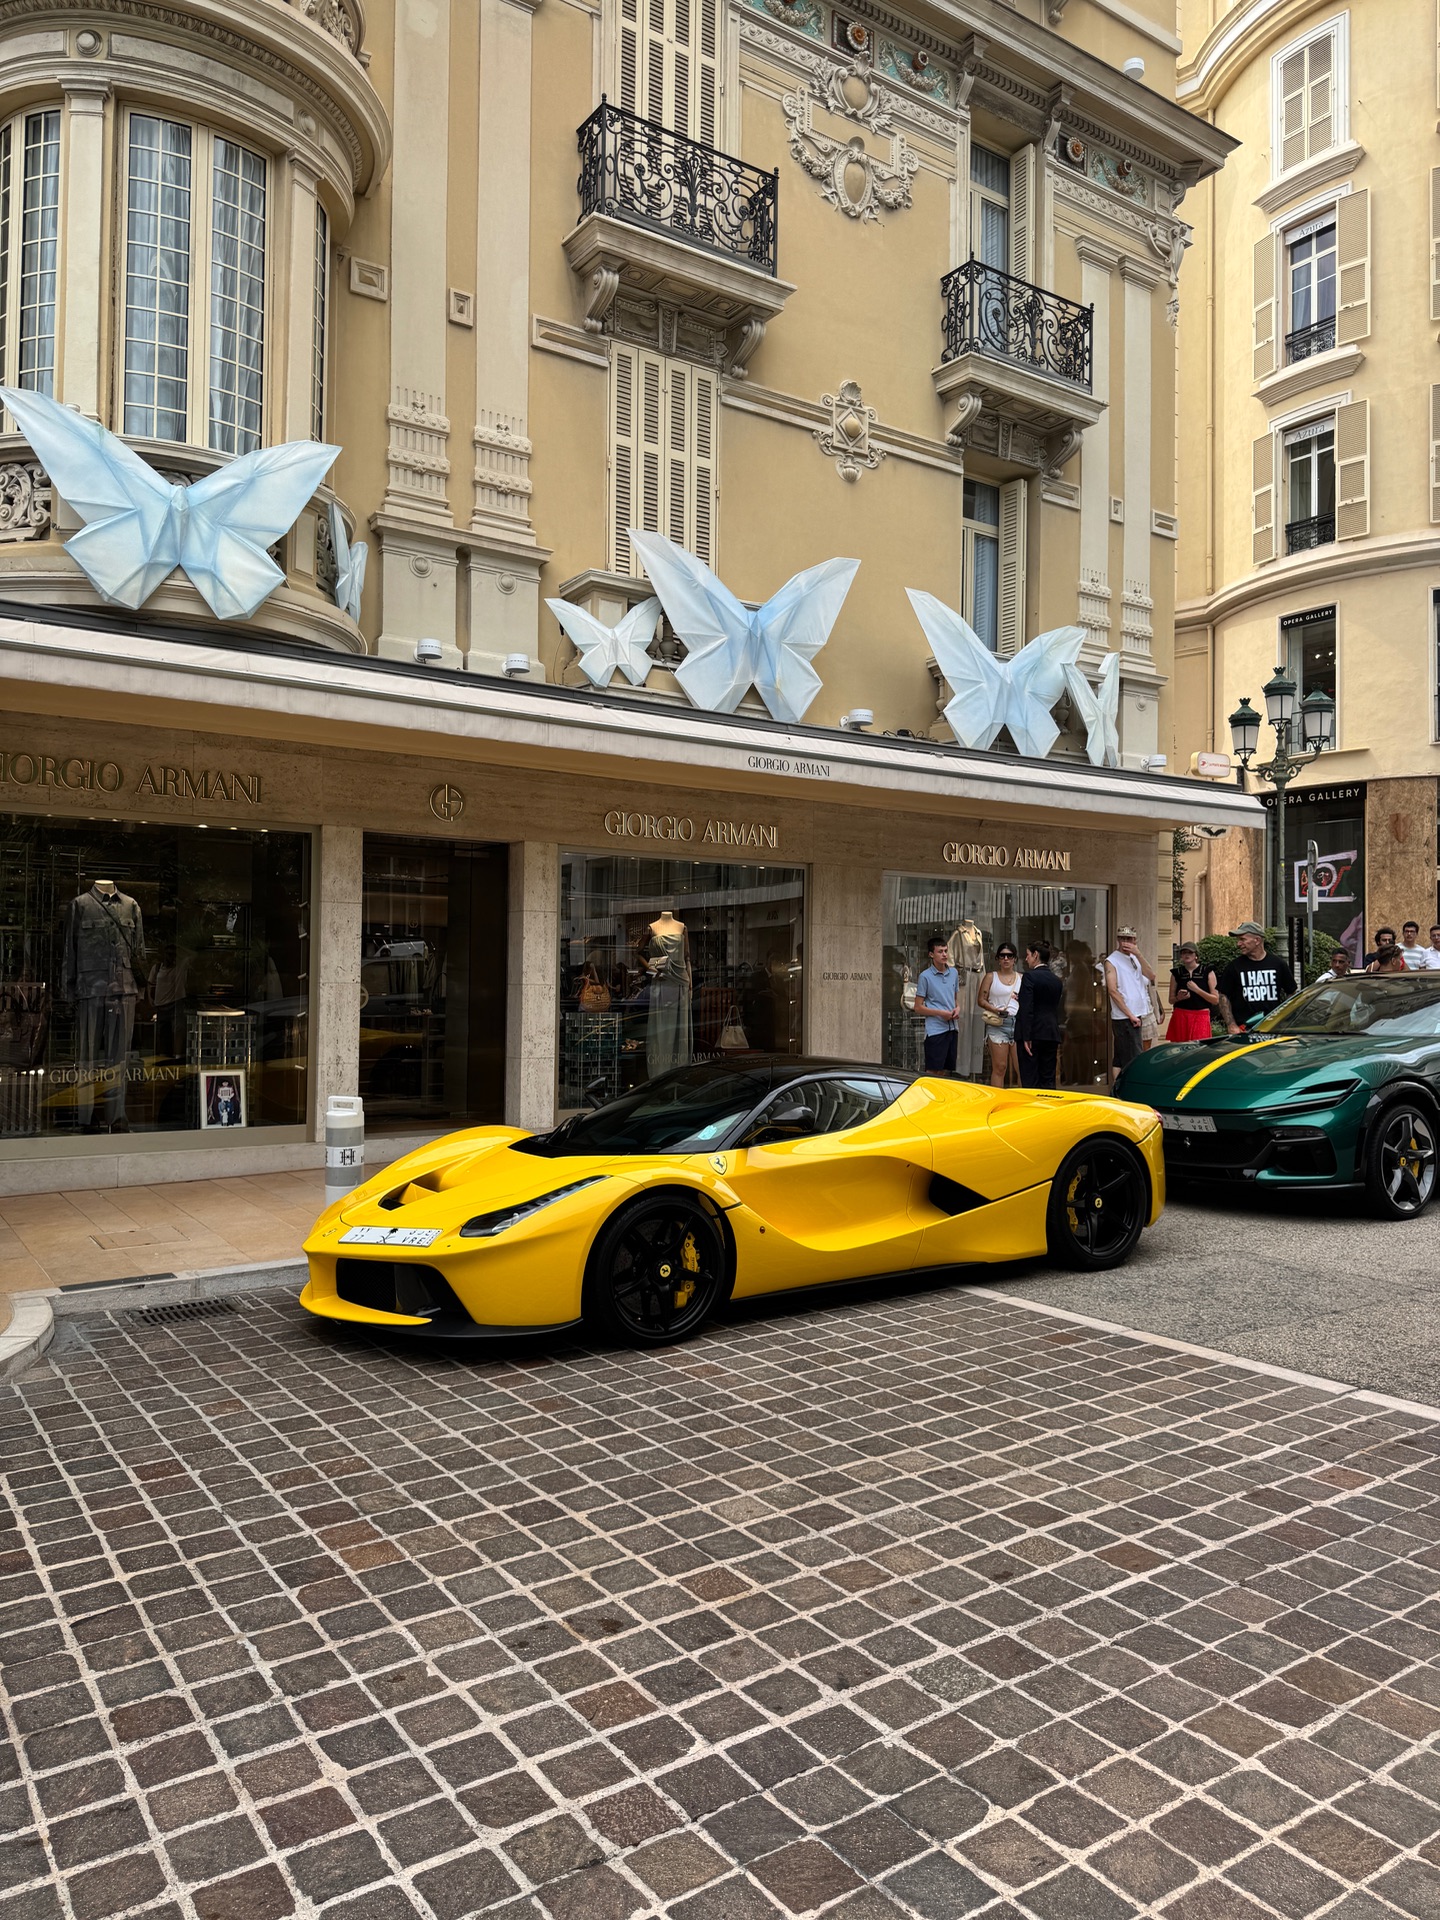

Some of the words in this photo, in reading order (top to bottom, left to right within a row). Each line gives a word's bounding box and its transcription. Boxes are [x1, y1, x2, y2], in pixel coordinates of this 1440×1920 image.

[1299, 221, 1324, 237] Azura
[1294, 424, 1325, 441] Azura
[1283, 617, 1303, 626] OPERA
[1305, 609, 1333, 621] GALLERY
[748, 756, 790, 772] GIORGIO
[793, 762, 830, 777] ARMANI
[0, 753, 123, 794] IORGIO
[135, 765, 263, 805] ARMANI
[1308, 788, 1360, 801] GALLERY
[604, 810, 696, 842] GIORGIO
[702, 819, 780, 849] ARMANI
[942, 841, 1010, 867] GIORGIO
[1013, 847, 1072, 871] ARMANI
[823, 972, 848, 981] GIORGIO
[850, 972, 872, 981] ARMANI
[1240, 971, 1246, 986] I
[1247, 969, 1277, 986] HATE
[1243, 985, 1278, 1002] PEOPLE
[50, 1067, 117, 1084] GIORGIO
[122, 1066, 180, 1081] ARMANI
